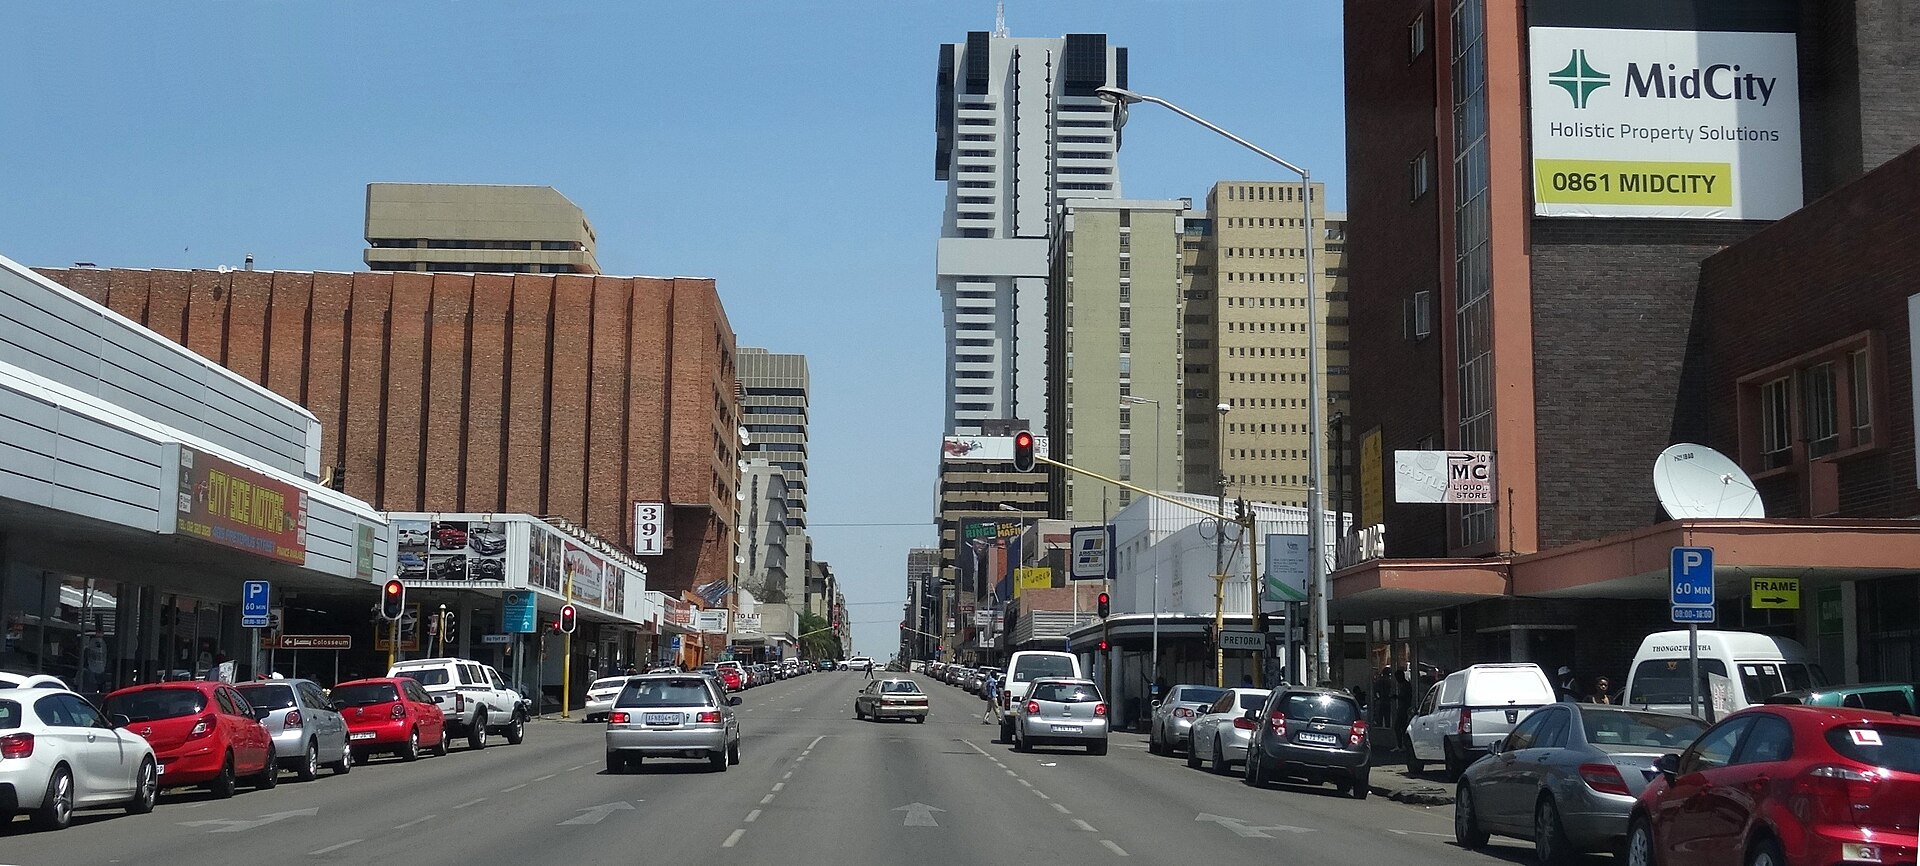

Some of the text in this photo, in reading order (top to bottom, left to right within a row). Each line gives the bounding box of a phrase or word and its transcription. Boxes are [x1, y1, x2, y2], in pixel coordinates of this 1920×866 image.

[1624, 62, 1777, 106] MidCity
[1550, 121, 1779, 144] Holistic Property Solutions
[1552, 172, 1717, 194] 0861 MIDCITY
[1476, 455, 1486, 463] 10
[1399, 463, 1447, 492] CASTLE
[1452, 464, 1488, 480] MC
[208, 468, 285, 535] CITY SIDE MOTORS
[642, 507, 657, 551] 391
[965, 527, 997, 538] RINGO
[1683, 552, 1703, 575] P
[250, 584, 263, 599] P
[1676, 583, 1711, 595] 60 MIN
[1754, 581, 1797, 591] FRAME
[1224, 636, 1261, 645] PRETORIA
[1855, 731, 1877, 742] L
